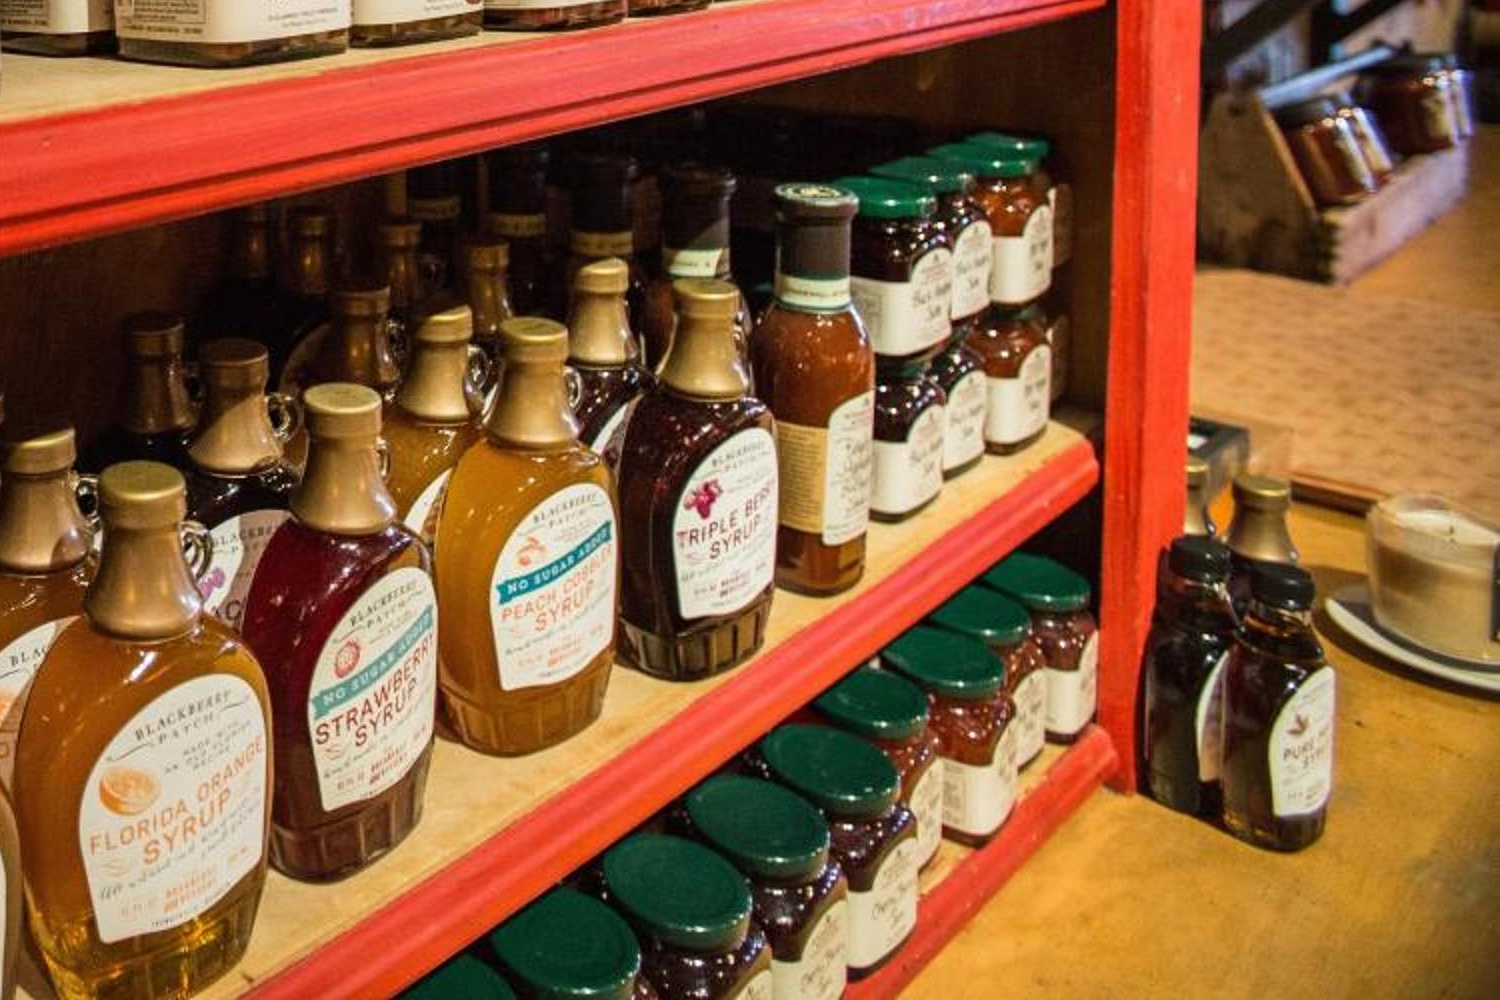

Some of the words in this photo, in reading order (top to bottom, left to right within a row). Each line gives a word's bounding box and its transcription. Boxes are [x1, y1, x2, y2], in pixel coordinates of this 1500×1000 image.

[675, 508, 739, 549] TRIPLE
[708, 514, 761, 560] SYRUP
[506, 578, 530, 596] NO
[533, 555, 575, 586] SUGAR
[349, 578, 419, 627] BLACKBERRY
[365, 599, 408, 629] PATCH
[499, 587, 558, 623] PEACH
[534, 579, 596, 633] SYRUP
[314, 632, 436, 746] STRAWBERRY
[322, 686, 347, 706] NO
[351, 655, 395, 692] SUGAR
[133, 688, 232, 743] BLACKBERRY
[156, 712, 216, 746] PATCH
[354, 677, 418, 748] SYRUP
[88, 798, 188, 856] FLORIDA
[195, 739, 264, 803] ORANGE
[143, 787, 232, 866] SYRUP
